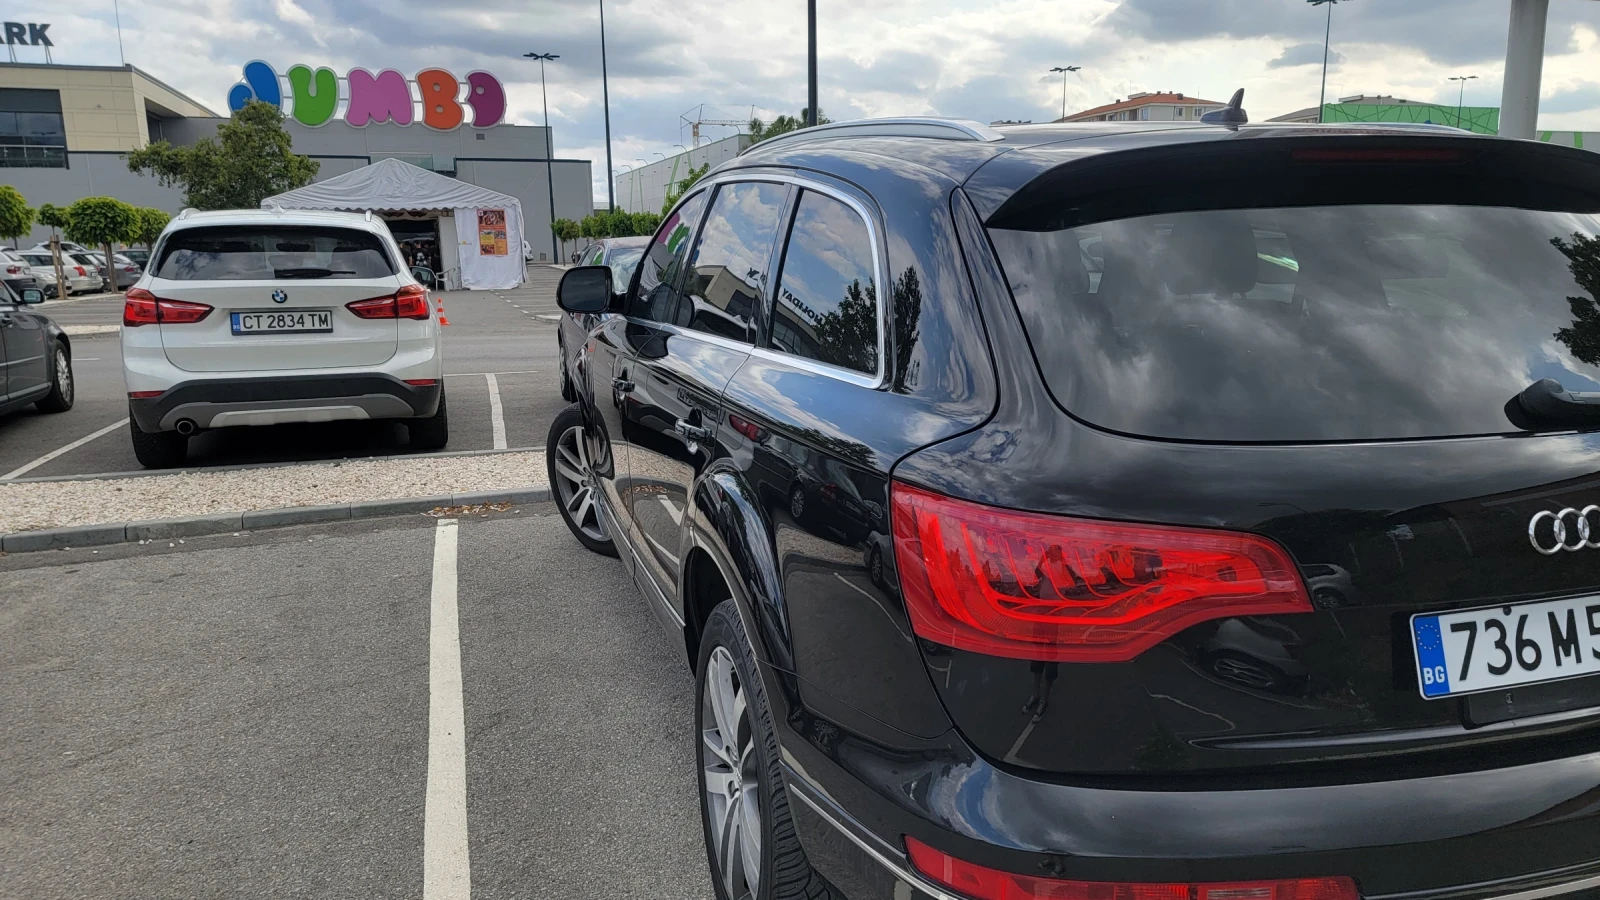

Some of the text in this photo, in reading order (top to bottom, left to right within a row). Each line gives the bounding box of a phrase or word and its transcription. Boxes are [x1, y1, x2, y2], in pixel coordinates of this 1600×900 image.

[0, 21, 54, 46] RK
[227, 59, 507, 132] JUMBO
[242, 315, 263, 329] CT
[267, 314, 305, 328] 2834
[308, 313, 329, 328] TM
[1423, 666, 1446, 685] BG
[1450, 614, 1542, 682] 736
